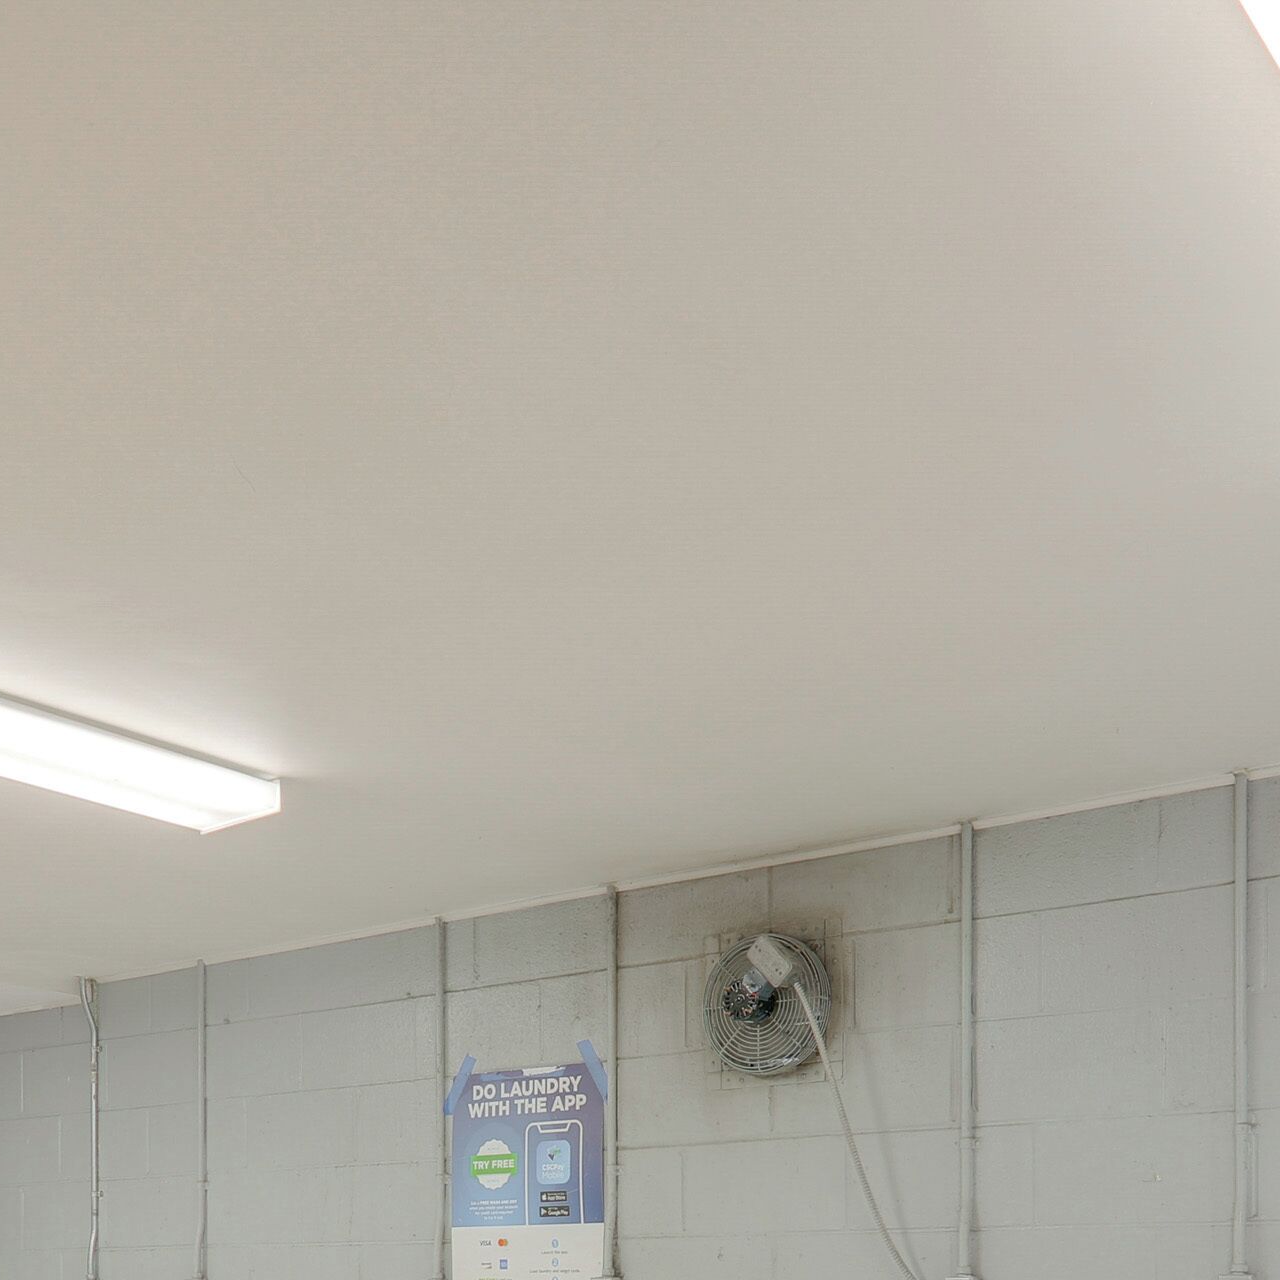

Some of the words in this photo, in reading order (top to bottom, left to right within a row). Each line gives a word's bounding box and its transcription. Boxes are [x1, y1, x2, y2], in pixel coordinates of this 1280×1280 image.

[472, 1084, 496, 1101] DO
[500, 1075, 582, 1098] LAUNDRY
[468, 1101, 510, 1118] WITH
[514, 1097, 548, 1115] THE
[551, 1094, 587, 1112] APP
[472, 1160, 490, 1170] TRY
[491, 1159, 515, 1169] FREE
